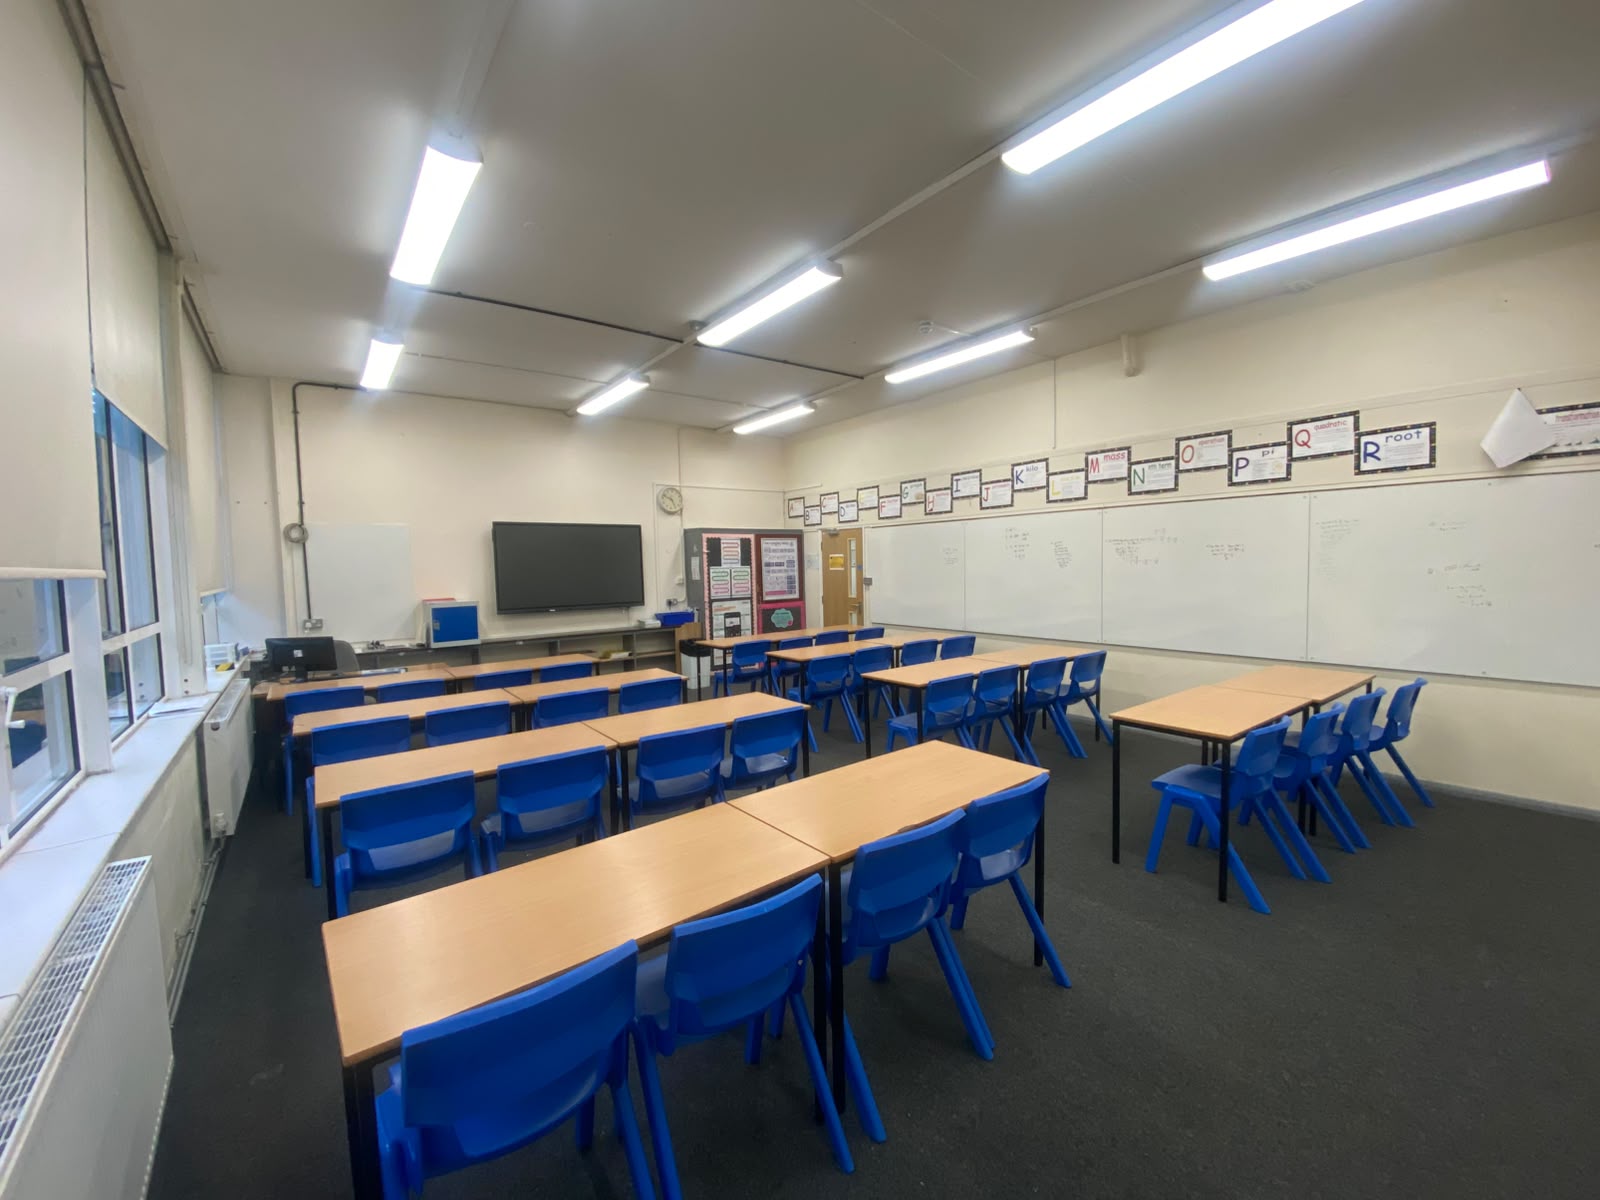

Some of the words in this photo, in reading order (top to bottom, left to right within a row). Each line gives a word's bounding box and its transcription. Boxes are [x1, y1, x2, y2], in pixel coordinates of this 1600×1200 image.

[1313, 419, 1348, 431] quadratic
[1294, 429, 1312, 449] Q
[1385, 430, 1423, 443] root
[1103, 451, 1126, 462] mass
[1181, 444, 1195, 464] O
[1261, 448, 1275, 457] pi
[1362, 441, 1382, 463] R
[1089, 456, 1100, 474] M
[1234, 457, 1250, 477] P
[1015, 469, 1025, 485] K
[1133, 467, 1145, 486] N
[954, 478, 961, 492] I
[1051, 480, 1061, 496] L
[903, 486, 909, 499] G
[983, 487, 991, 502] J
[880, 501, 887, 513] F
[928, 495, 935, 508] H
[840, 506, 846, 517] D
